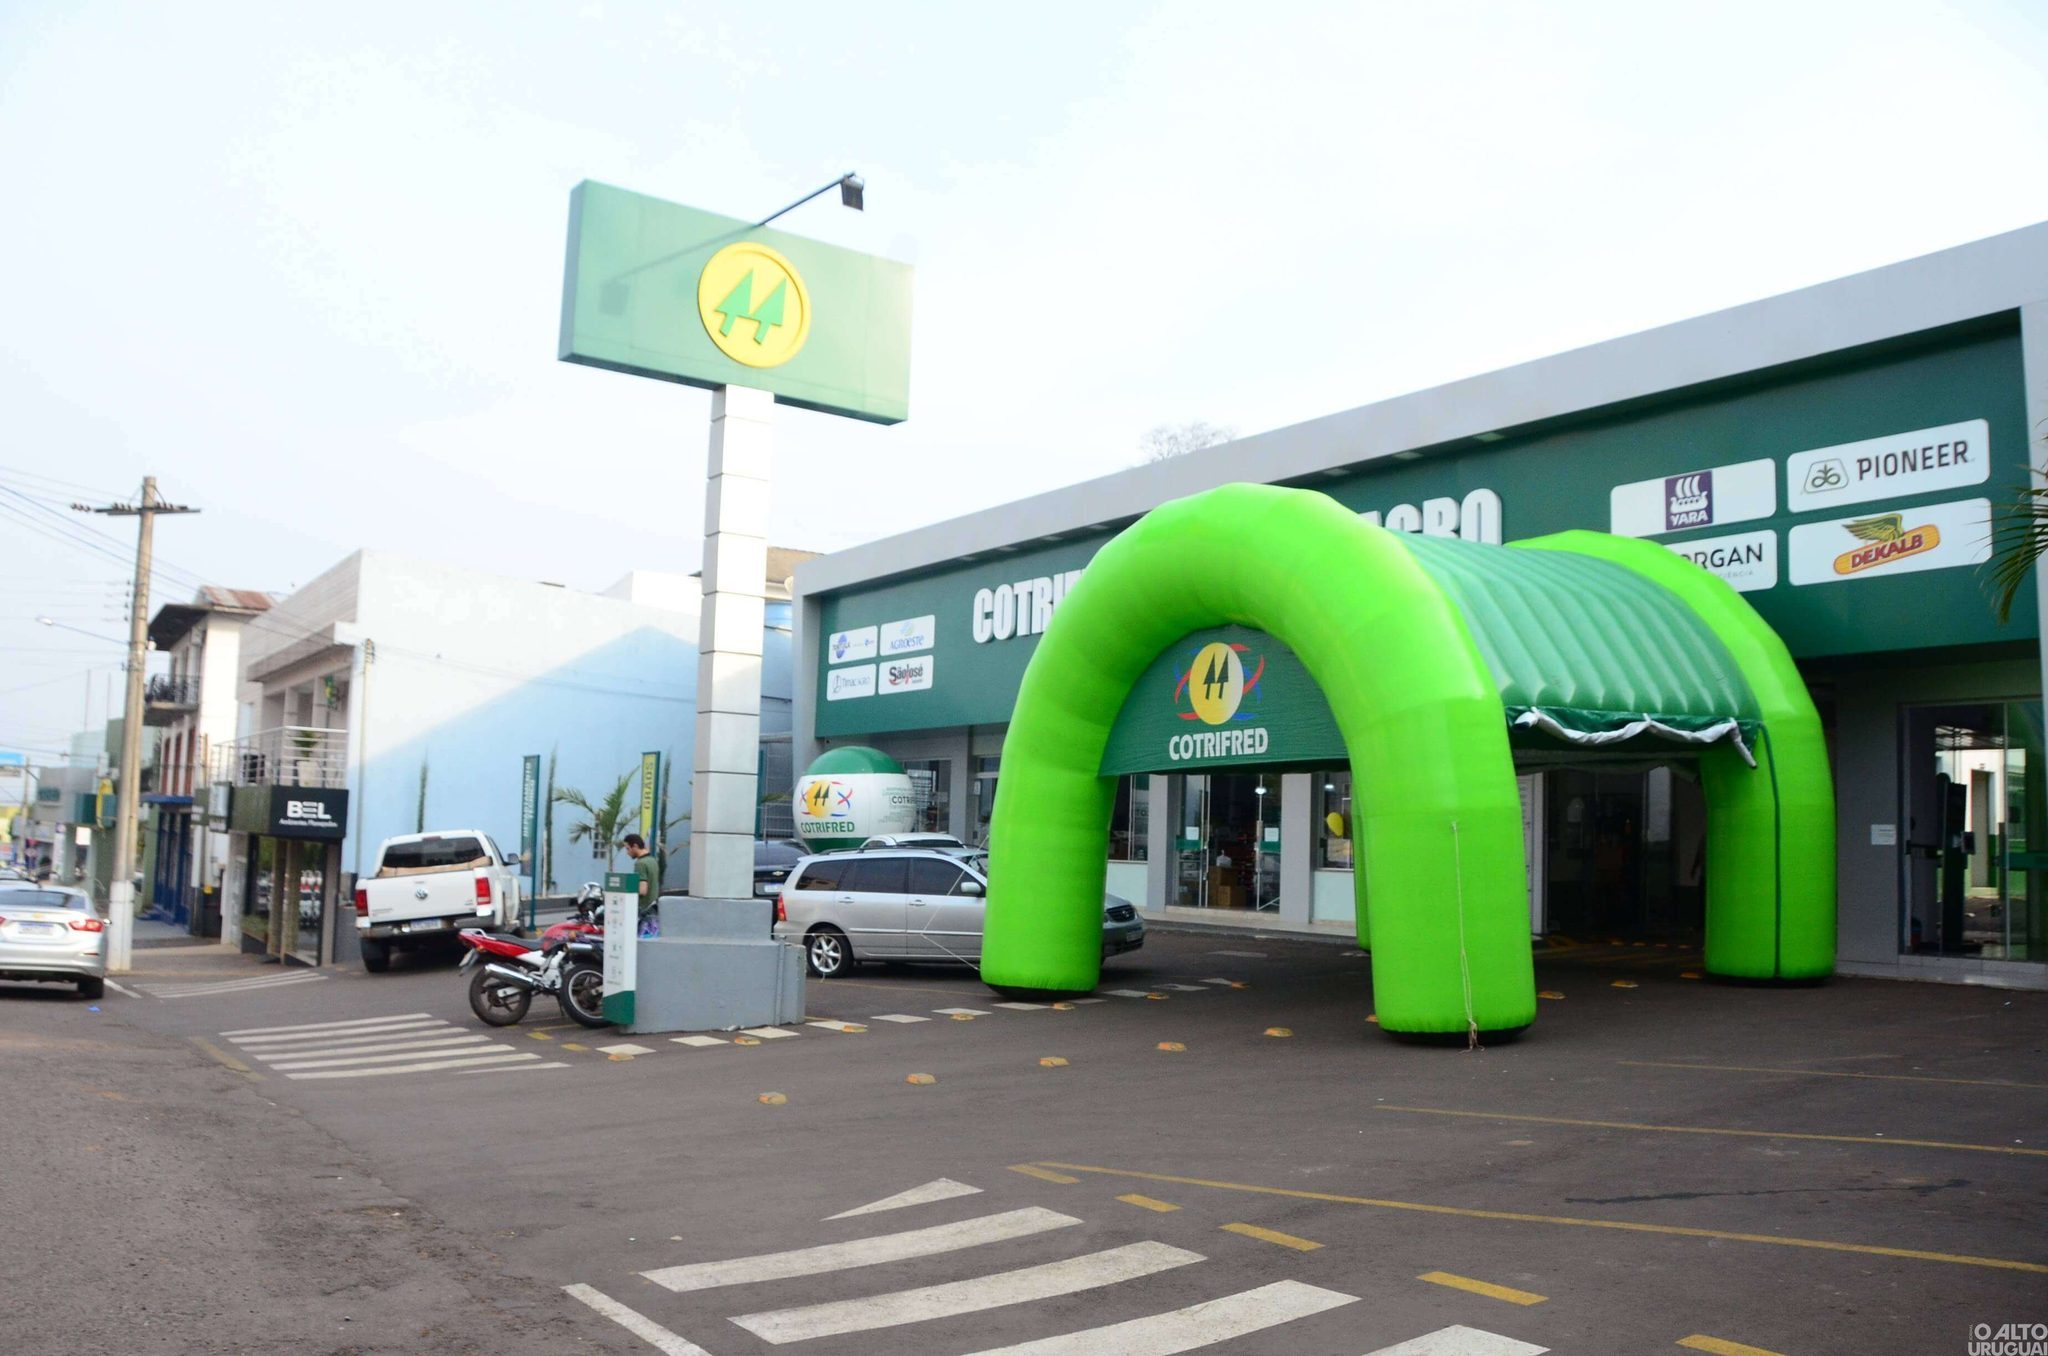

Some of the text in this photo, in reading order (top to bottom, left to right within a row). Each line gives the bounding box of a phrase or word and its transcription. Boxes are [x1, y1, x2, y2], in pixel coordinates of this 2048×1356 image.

[1856, 440, 1969, 481] PIONEER
[1670, 509, 1709, 527] YARA
[1851, 534, 1924, 568] DEKALB
[1169, 727, 1268, 760] COTRIFRED
[287, 801, 332, 819] BEL
[800, 821, 855, 833] COTRIFRED
